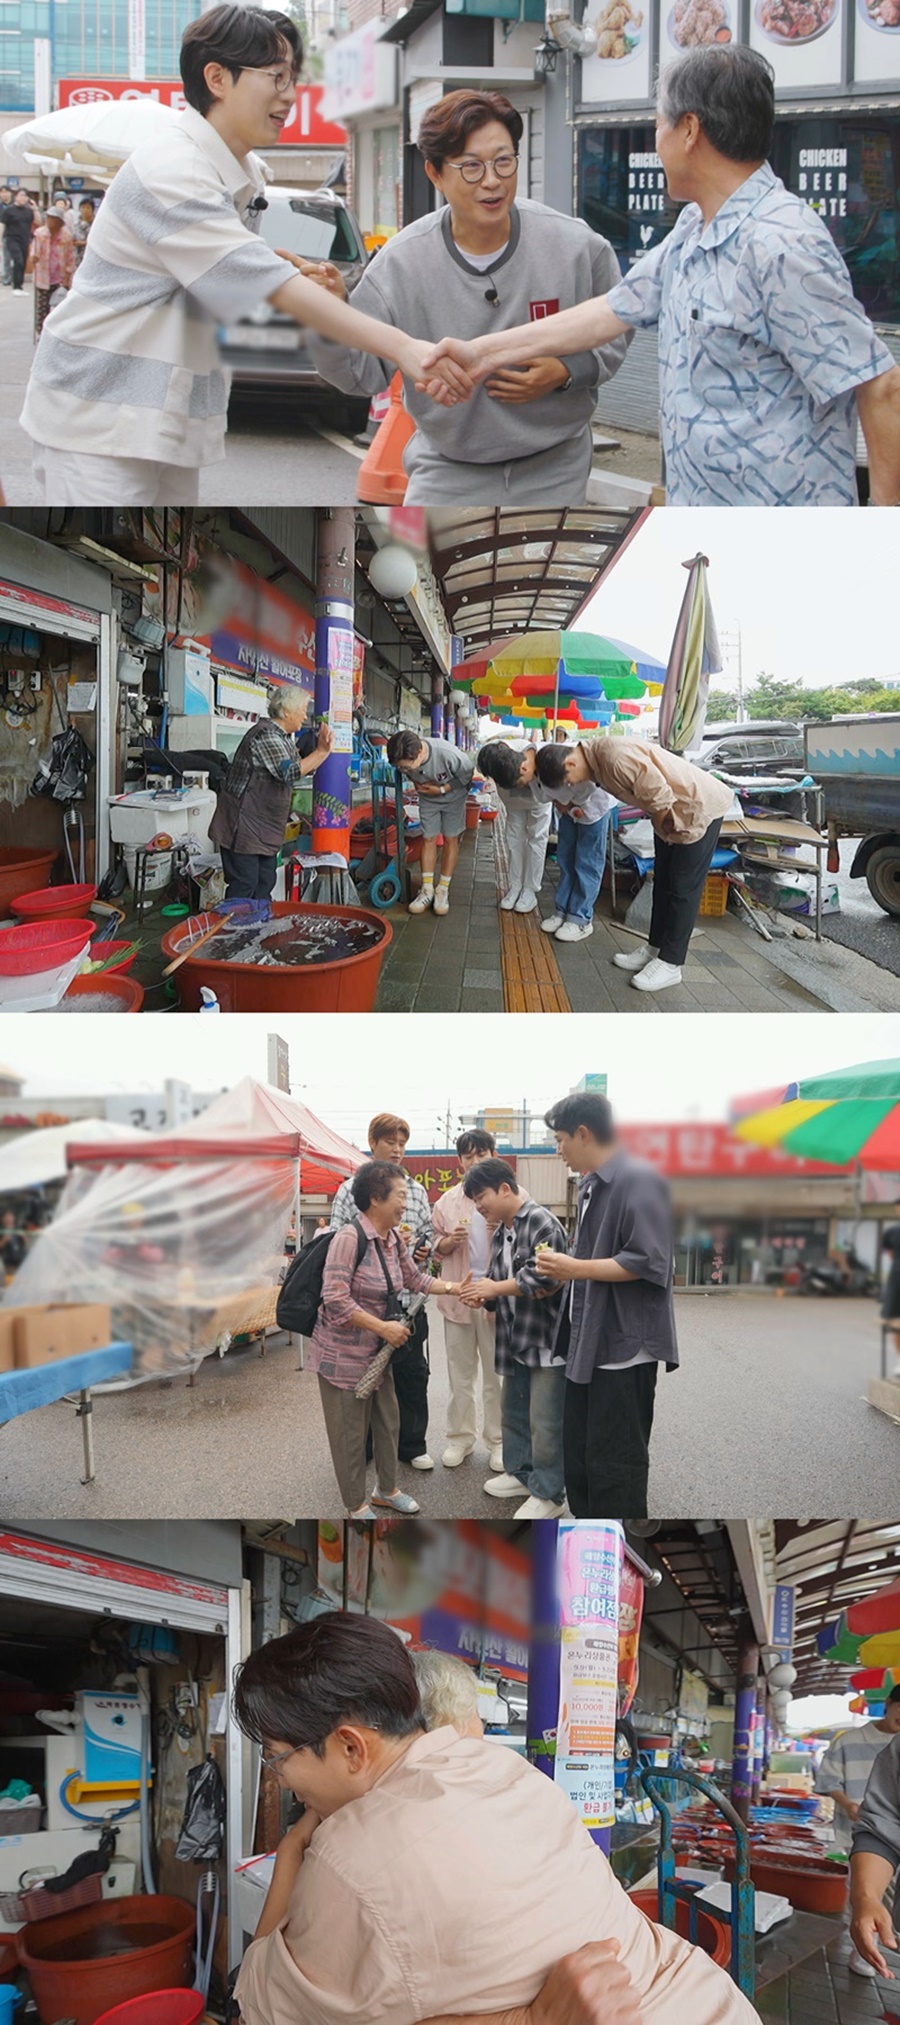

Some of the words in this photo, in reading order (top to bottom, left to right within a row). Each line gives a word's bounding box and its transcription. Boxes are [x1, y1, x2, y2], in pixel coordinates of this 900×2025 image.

[799, 149, 847, 167] CHICKEN
[628, 173, 664, 189] BEER
[799, 173, 847, 191] BEER
[628, 194, 664, 211] PLATE
[570, 1791, 587, 1801] 법인
[583, 1802, 601, 1814] 환급
